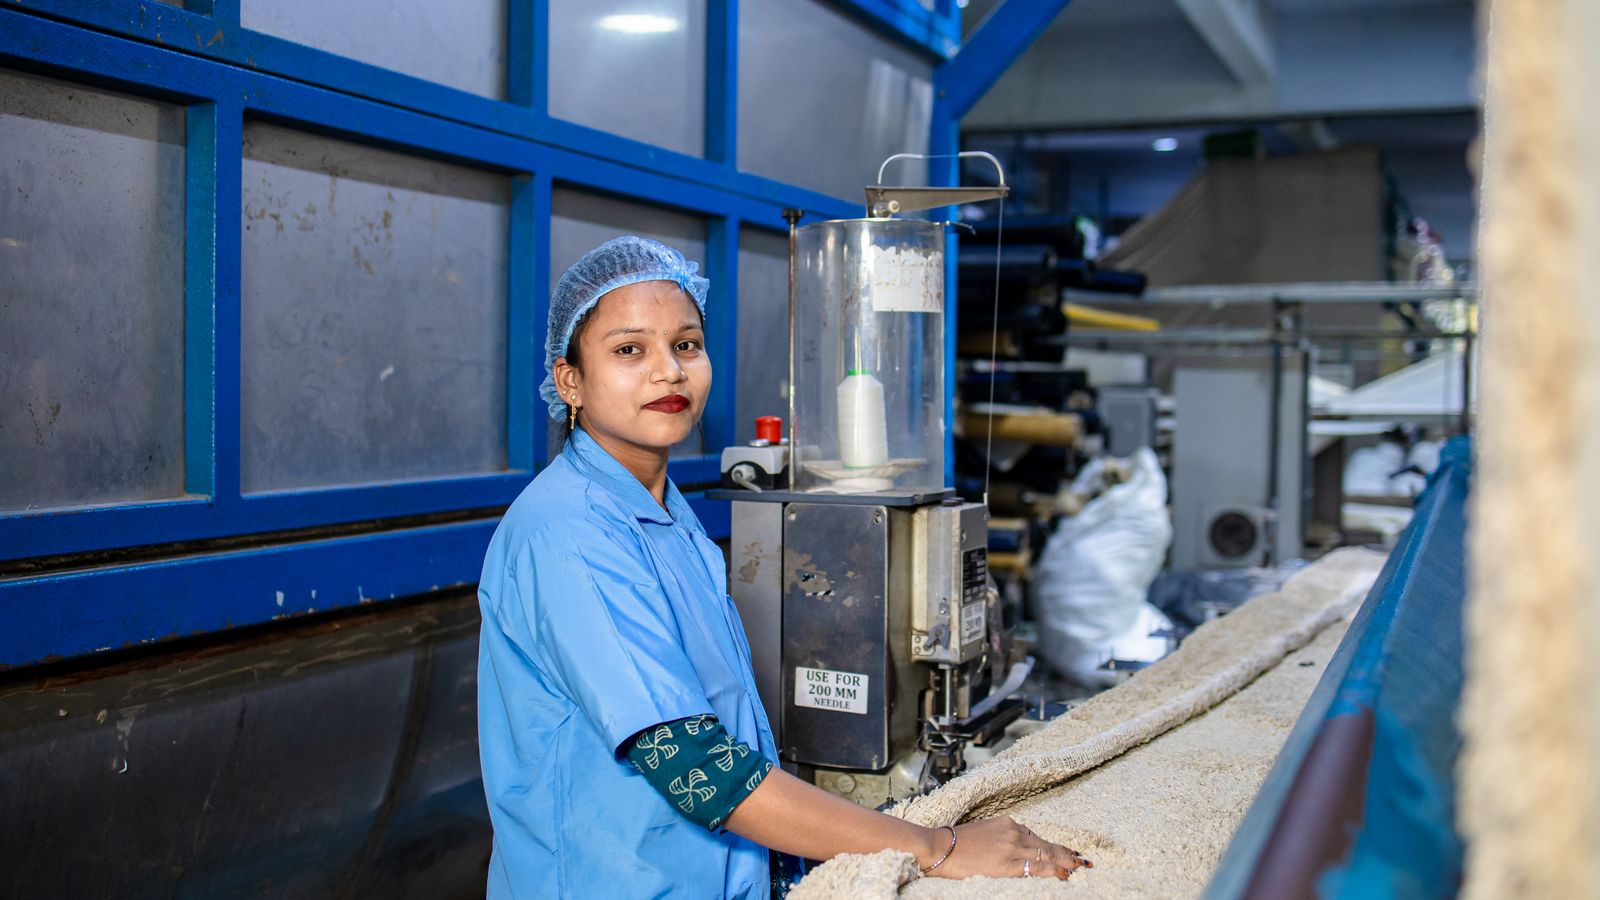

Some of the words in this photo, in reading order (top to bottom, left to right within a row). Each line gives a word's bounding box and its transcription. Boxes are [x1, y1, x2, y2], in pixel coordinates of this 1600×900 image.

[806, 670, 829, 683] USE
[835, 673, 860, 686] FOR
[809, 683, 831, 696] 200
[835, 687, 857, 700] MM
[814, 697, 851, 709] NEEDLE
